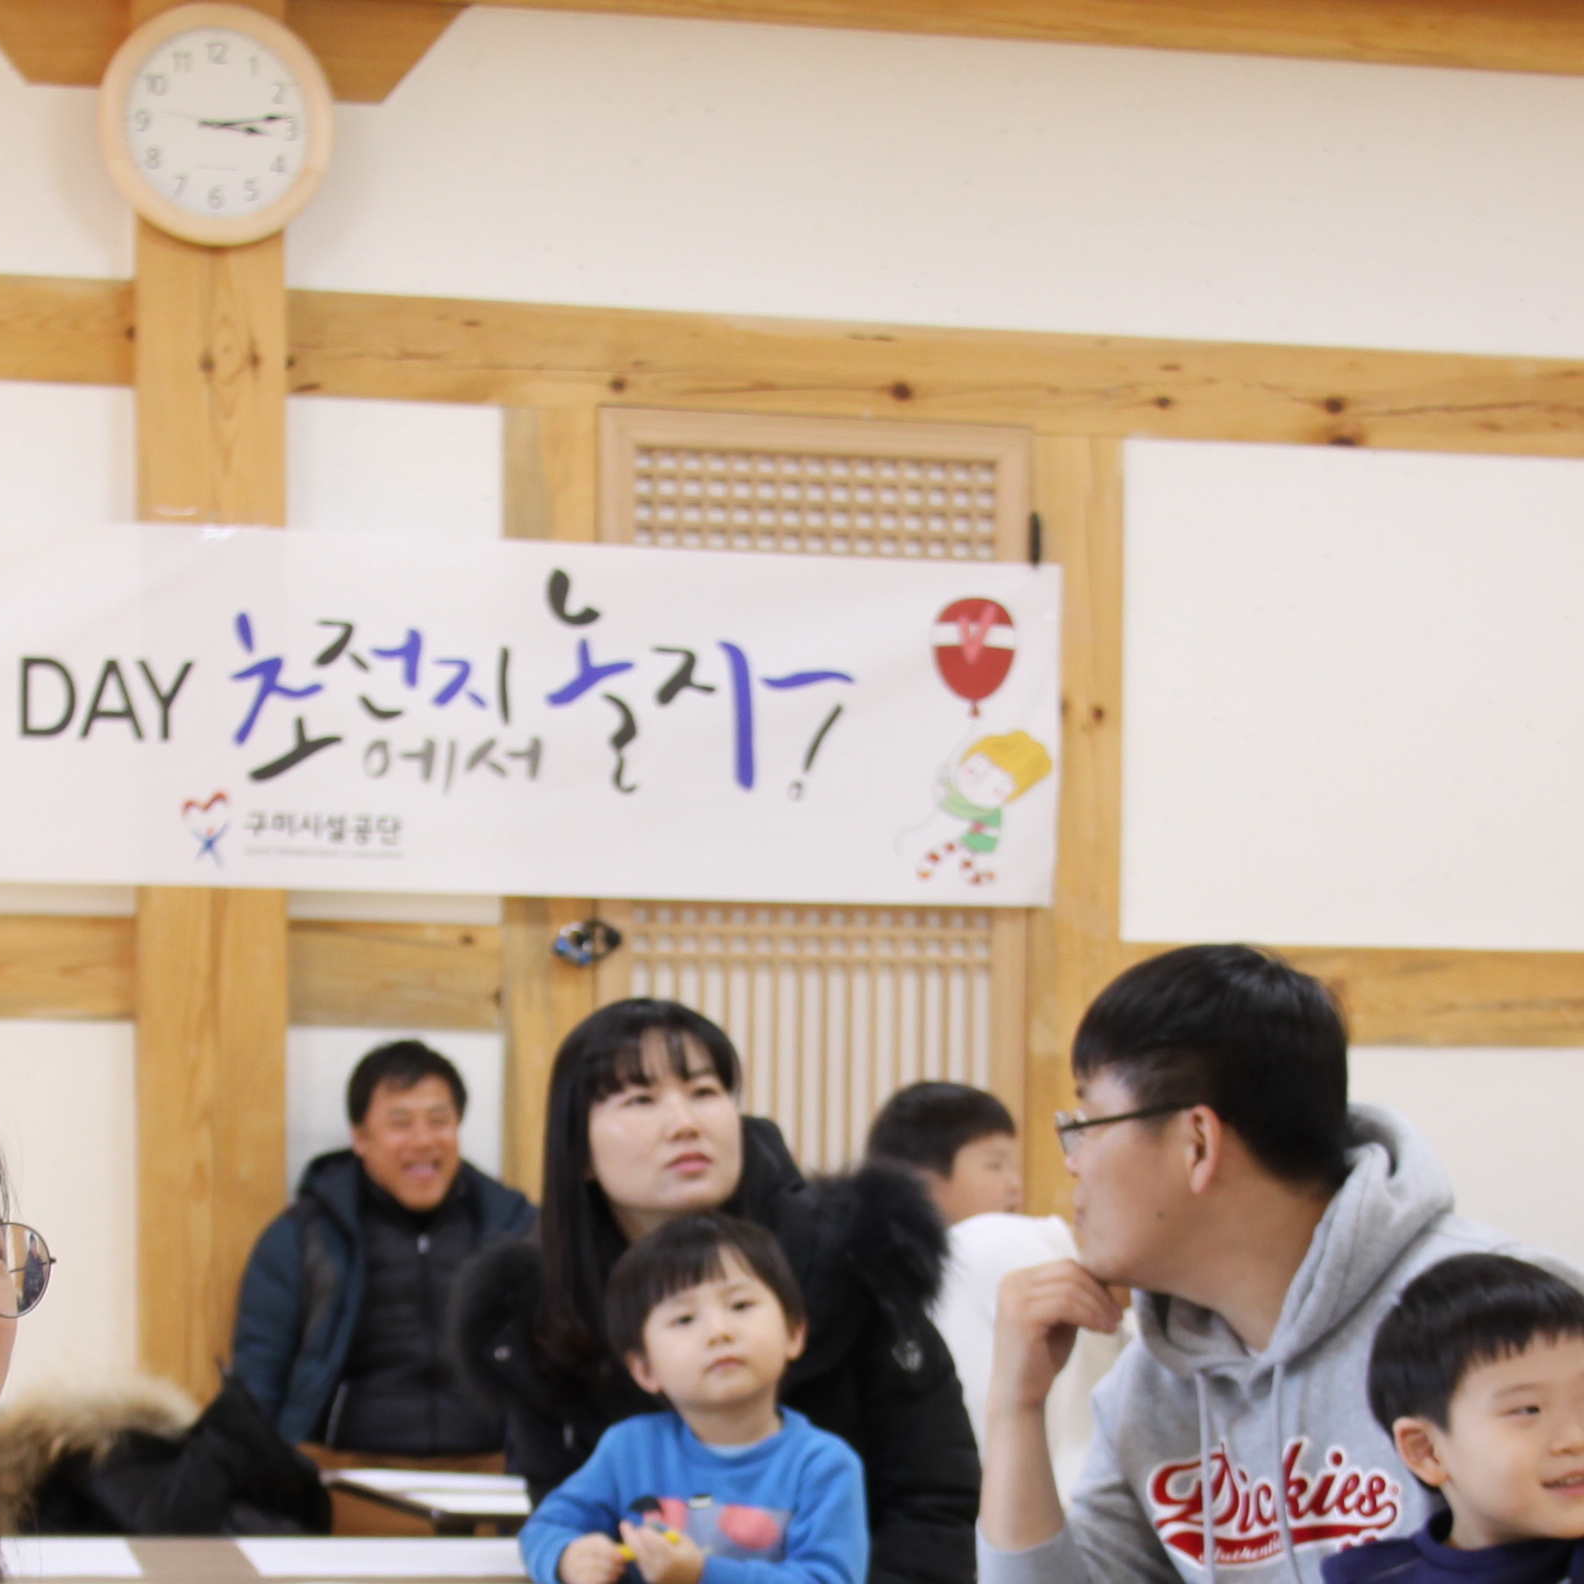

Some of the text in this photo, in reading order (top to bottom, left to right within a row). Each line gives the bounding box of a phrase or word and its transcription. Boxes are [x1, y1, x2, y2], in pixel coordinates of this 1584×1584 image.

[206, 41, 227, 65] 12
[145, 73, 167, 97] 10
[271, 80, 286, 104] 2
[134, 108, 151, 132] 9
[207, 186, 225, 210] 6
[19, 656, 194, 741] DAY
[363, 736, 542, 796] 에서
[245, 809, 402, 846] 구미시설공단
[1150, 1439, 1391, 1535] Dickies
